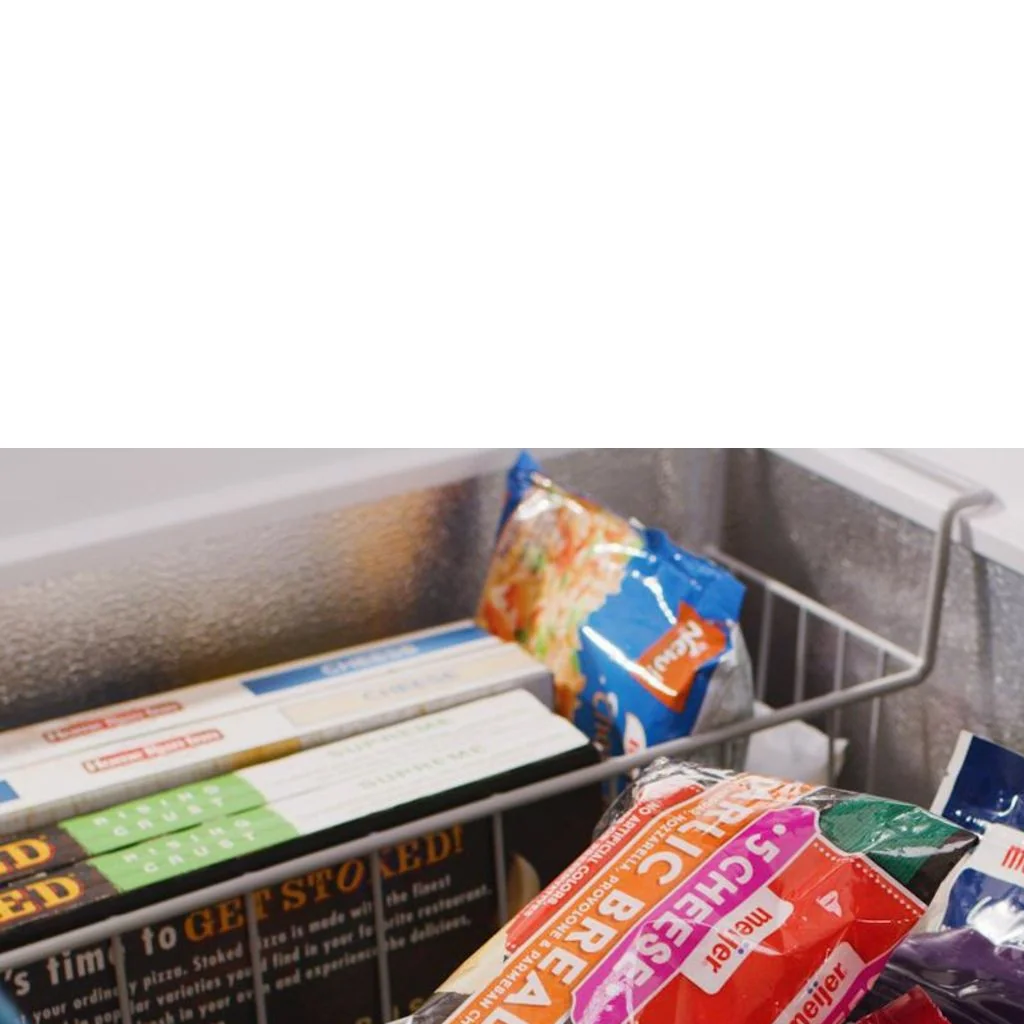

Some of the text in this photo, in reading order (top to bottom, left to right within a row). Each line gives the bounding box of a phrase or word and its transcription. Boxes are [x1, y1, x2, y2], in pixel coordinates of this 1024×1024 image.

[592, 814, 642, 865] ARTIFICIAL
[744, 832, 781, 864] 5
[192, 940, 244, 971] Stoked
[309, 911, 345, 933] made
[412, 873, 452, 898] finest
[550, 874, 621, 940] PROVOLONE
[613, 856, 755, 989] CHEESE
[141, 924, 177, 956] to
[272, 949, 301, 974] find
[704, 905, 774, 975] meijer
[276, 967, 301, 990] and
[480, 950, 541, 1009] PARMESAN
